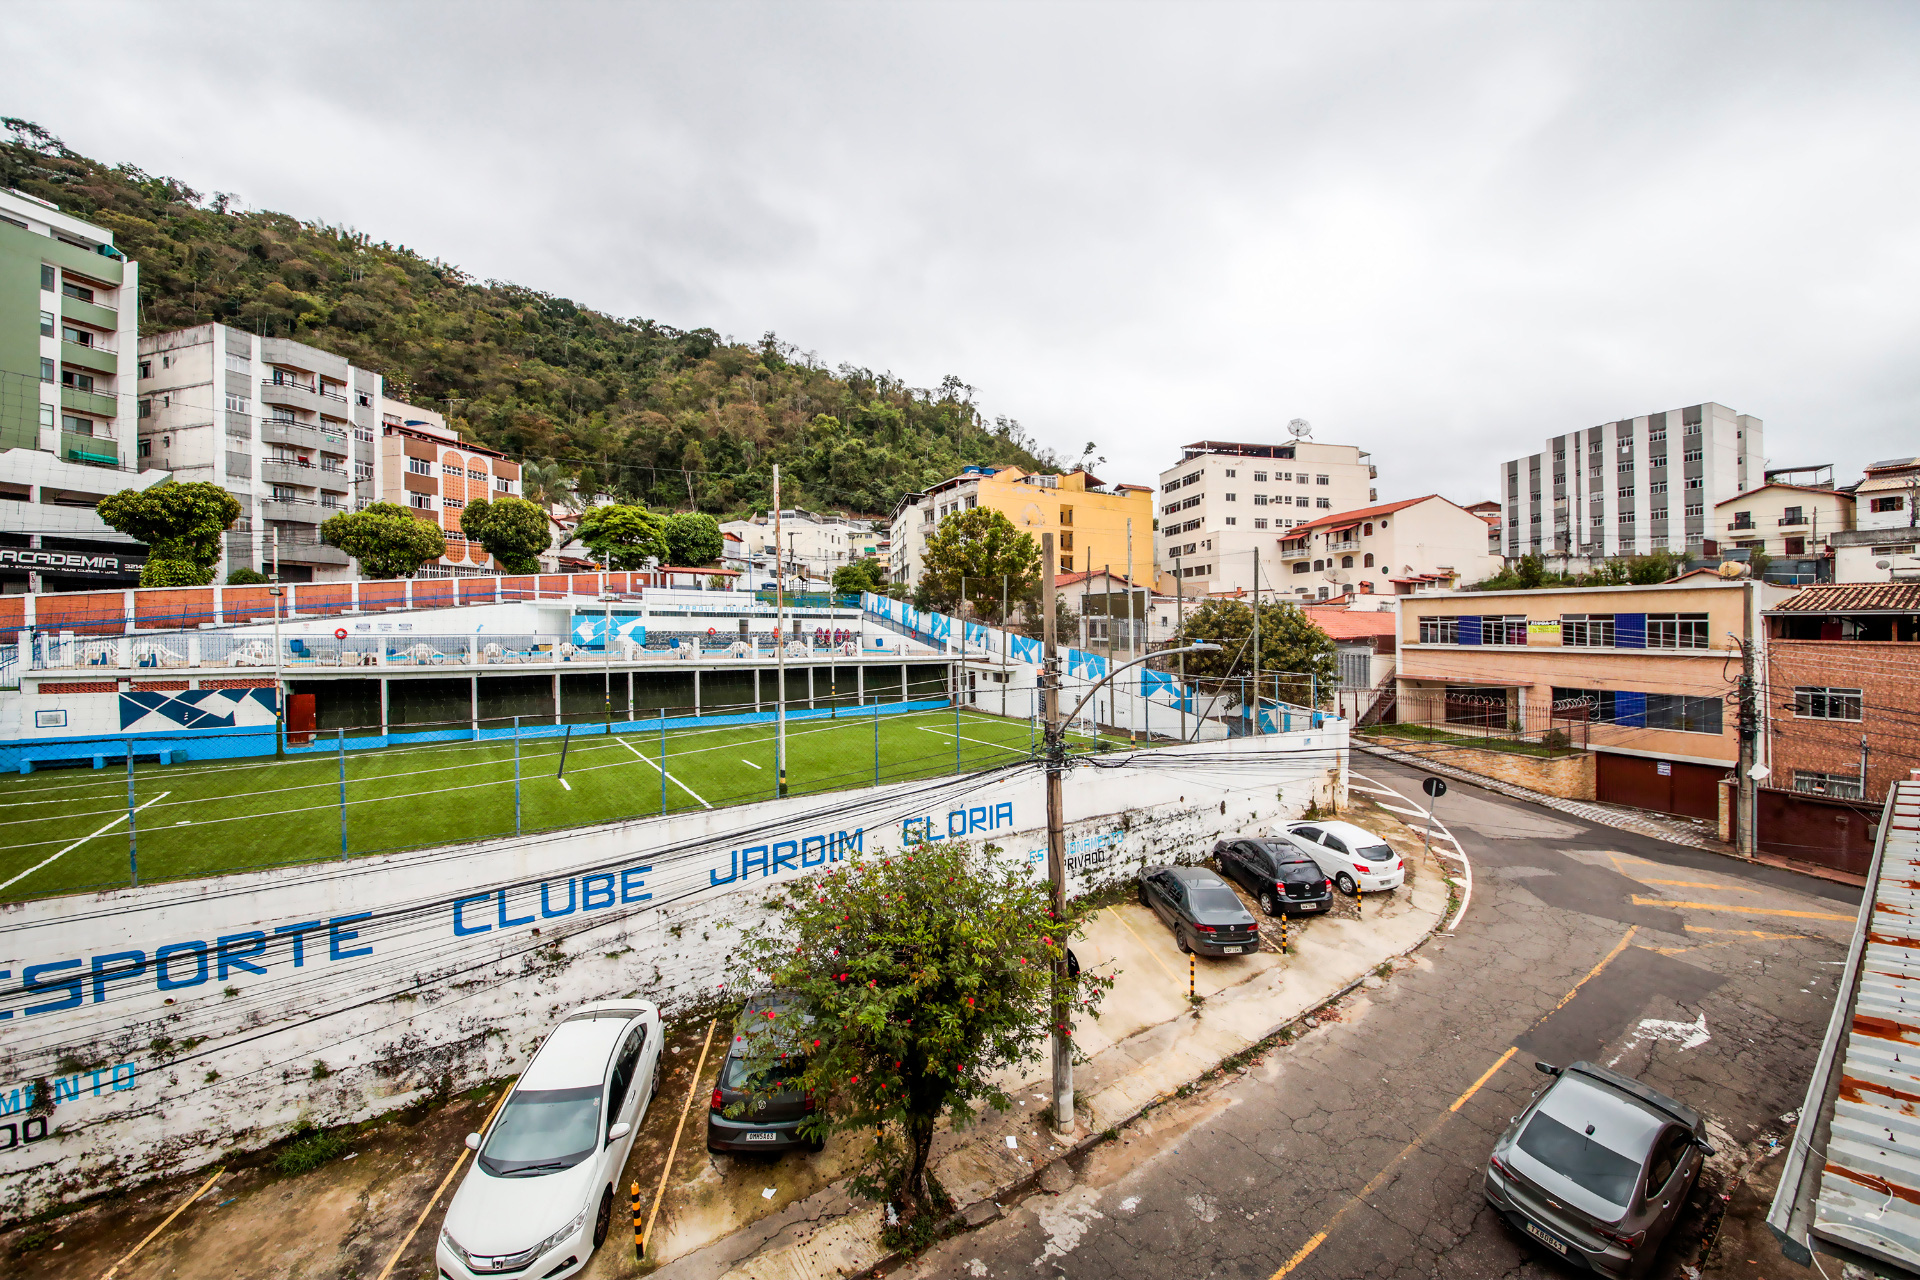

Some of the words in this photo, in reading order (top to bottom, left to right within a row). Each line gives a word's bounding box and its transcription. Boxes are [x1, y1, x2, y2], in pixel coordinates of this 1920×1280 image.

[0, 550, 119, 569] ACADEMIA
[1029, 831, 1123, 863] ESIONAMENTO
[1064, 849, 1105, 870] RIVADO
[453, 865, 653, 937] CLUBE
[709, 827, 863, 887] JARDIM
[903, 801, 1013, 847] GLÓRIA
